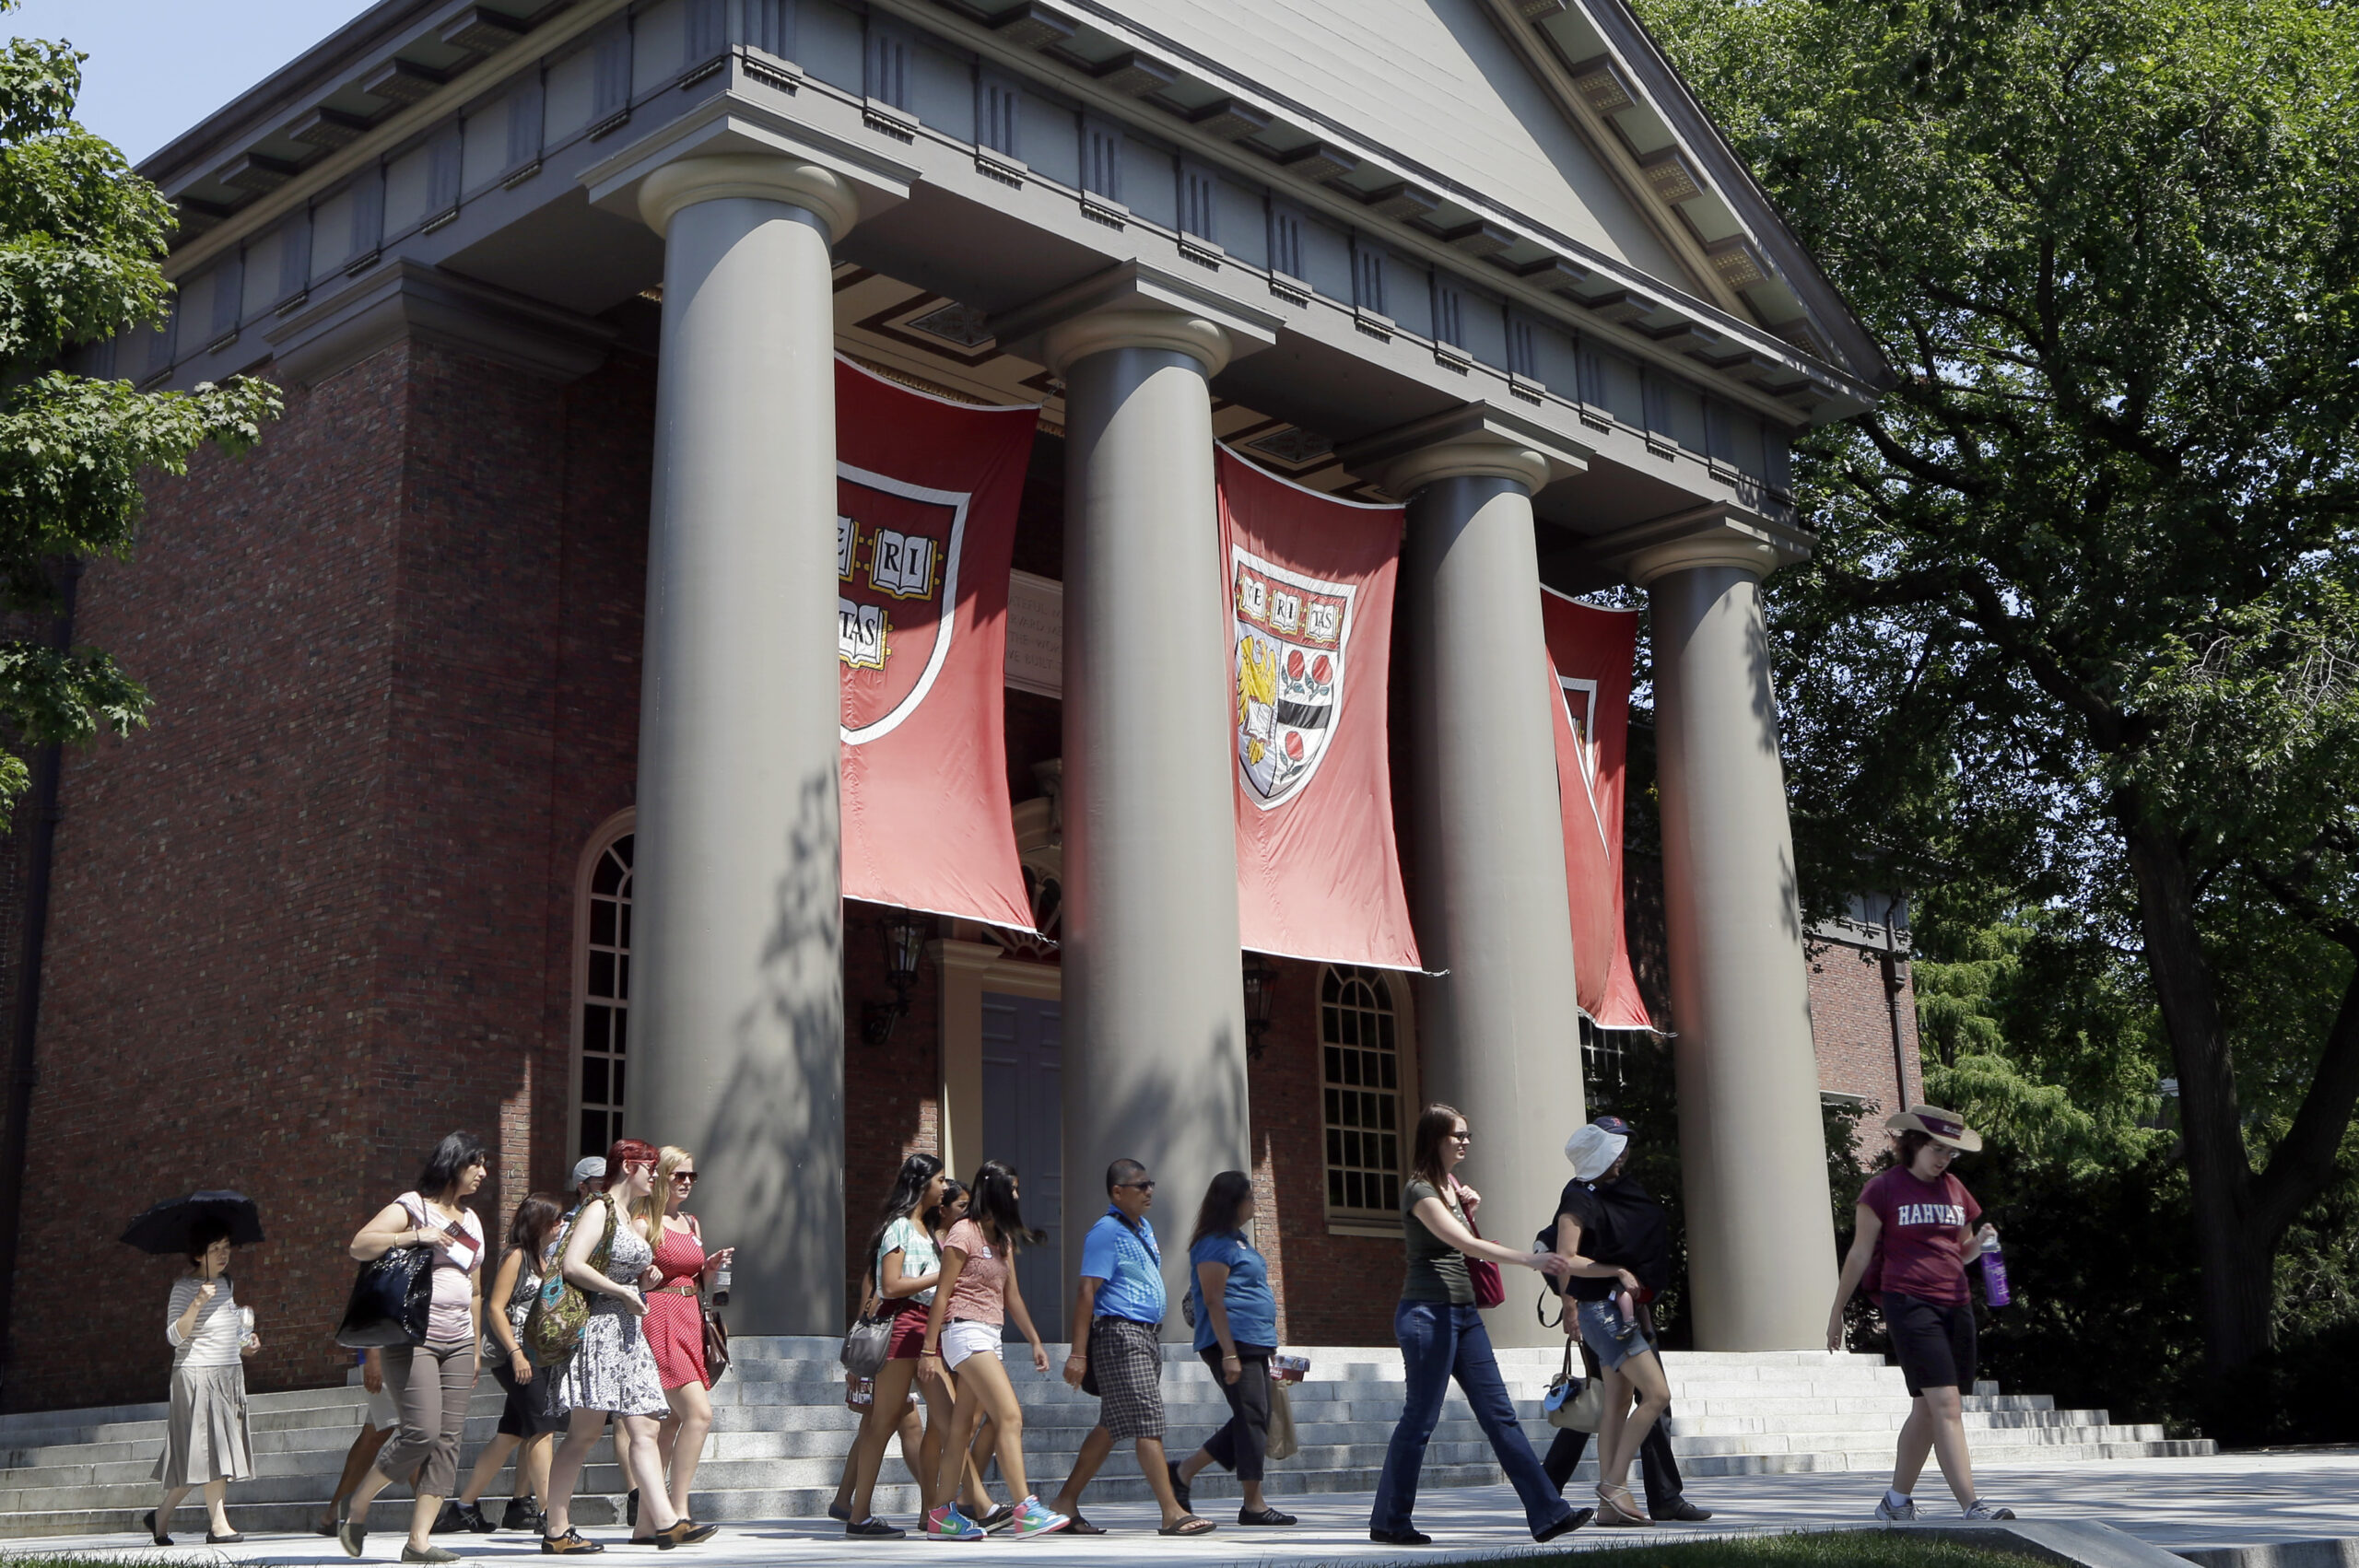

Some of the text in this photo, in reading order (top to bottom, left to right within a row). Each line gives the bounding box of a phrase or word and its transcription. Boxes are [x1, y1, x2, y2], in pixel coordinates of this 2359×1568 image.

[884, 541, 920, 576] RI
[839, 610, 875, 646] TAS
[1276, 599, 1294, 619] RI
[1311, 610, 1332, 629] TAS
[1898, 1203, 1966, 1226] HAHVAH
